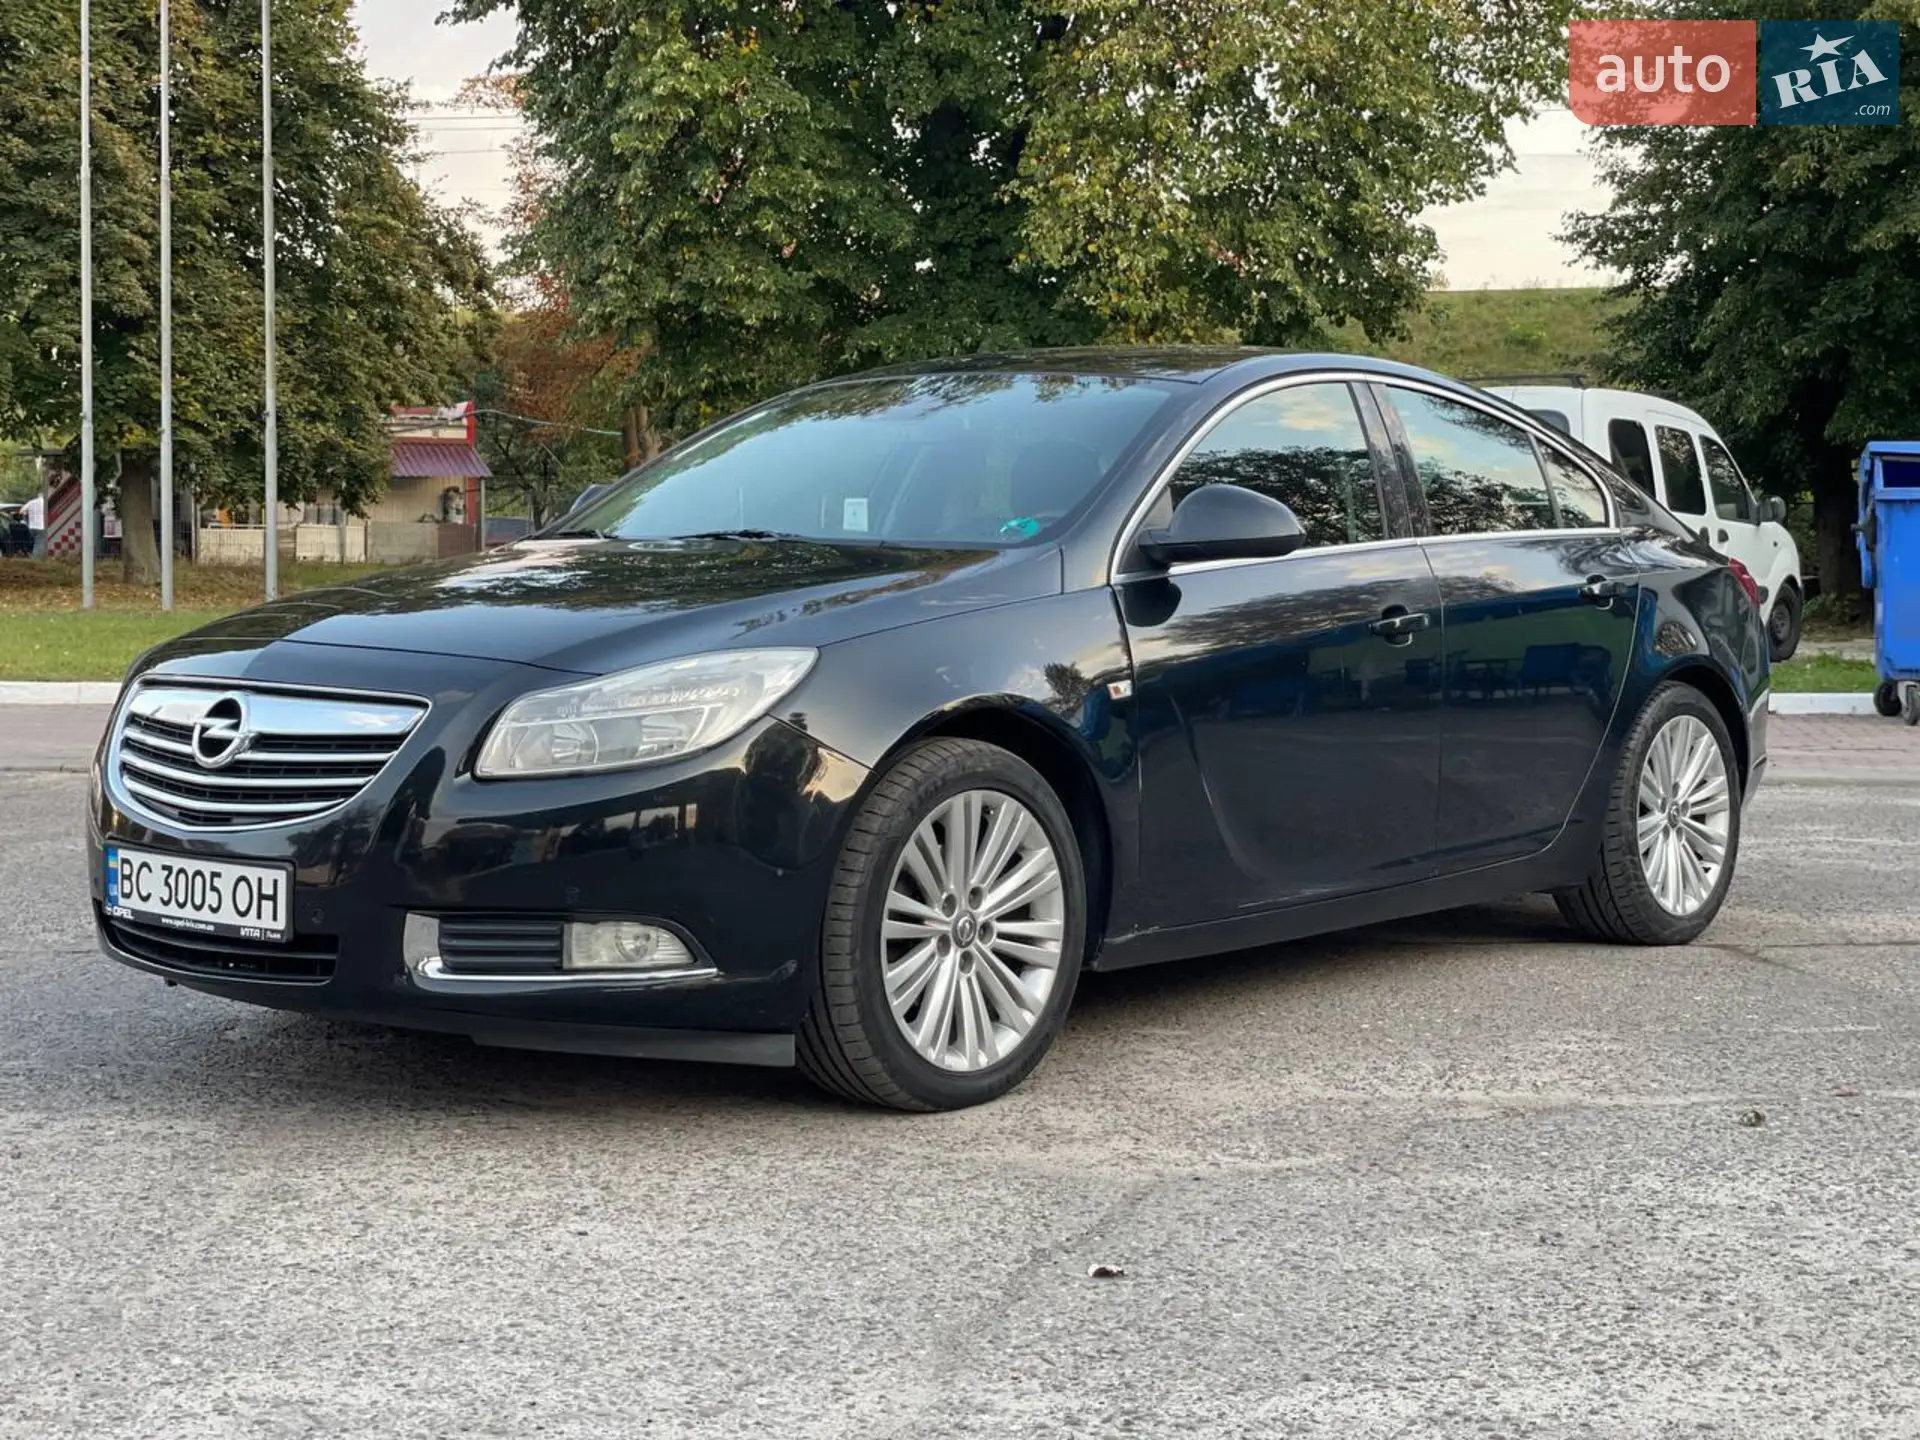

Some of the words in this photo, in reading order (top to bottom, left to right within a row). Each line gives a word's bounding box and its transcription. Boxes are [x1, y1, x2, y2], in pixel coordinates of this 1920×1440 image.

[120, 857, 153, 902] BC
[160, 864, 223, 914] 3005
[232, 875, 278, 922] OH
[112, 906, 135, 919] OPEL
[239, 927, 261, 937] VITA
